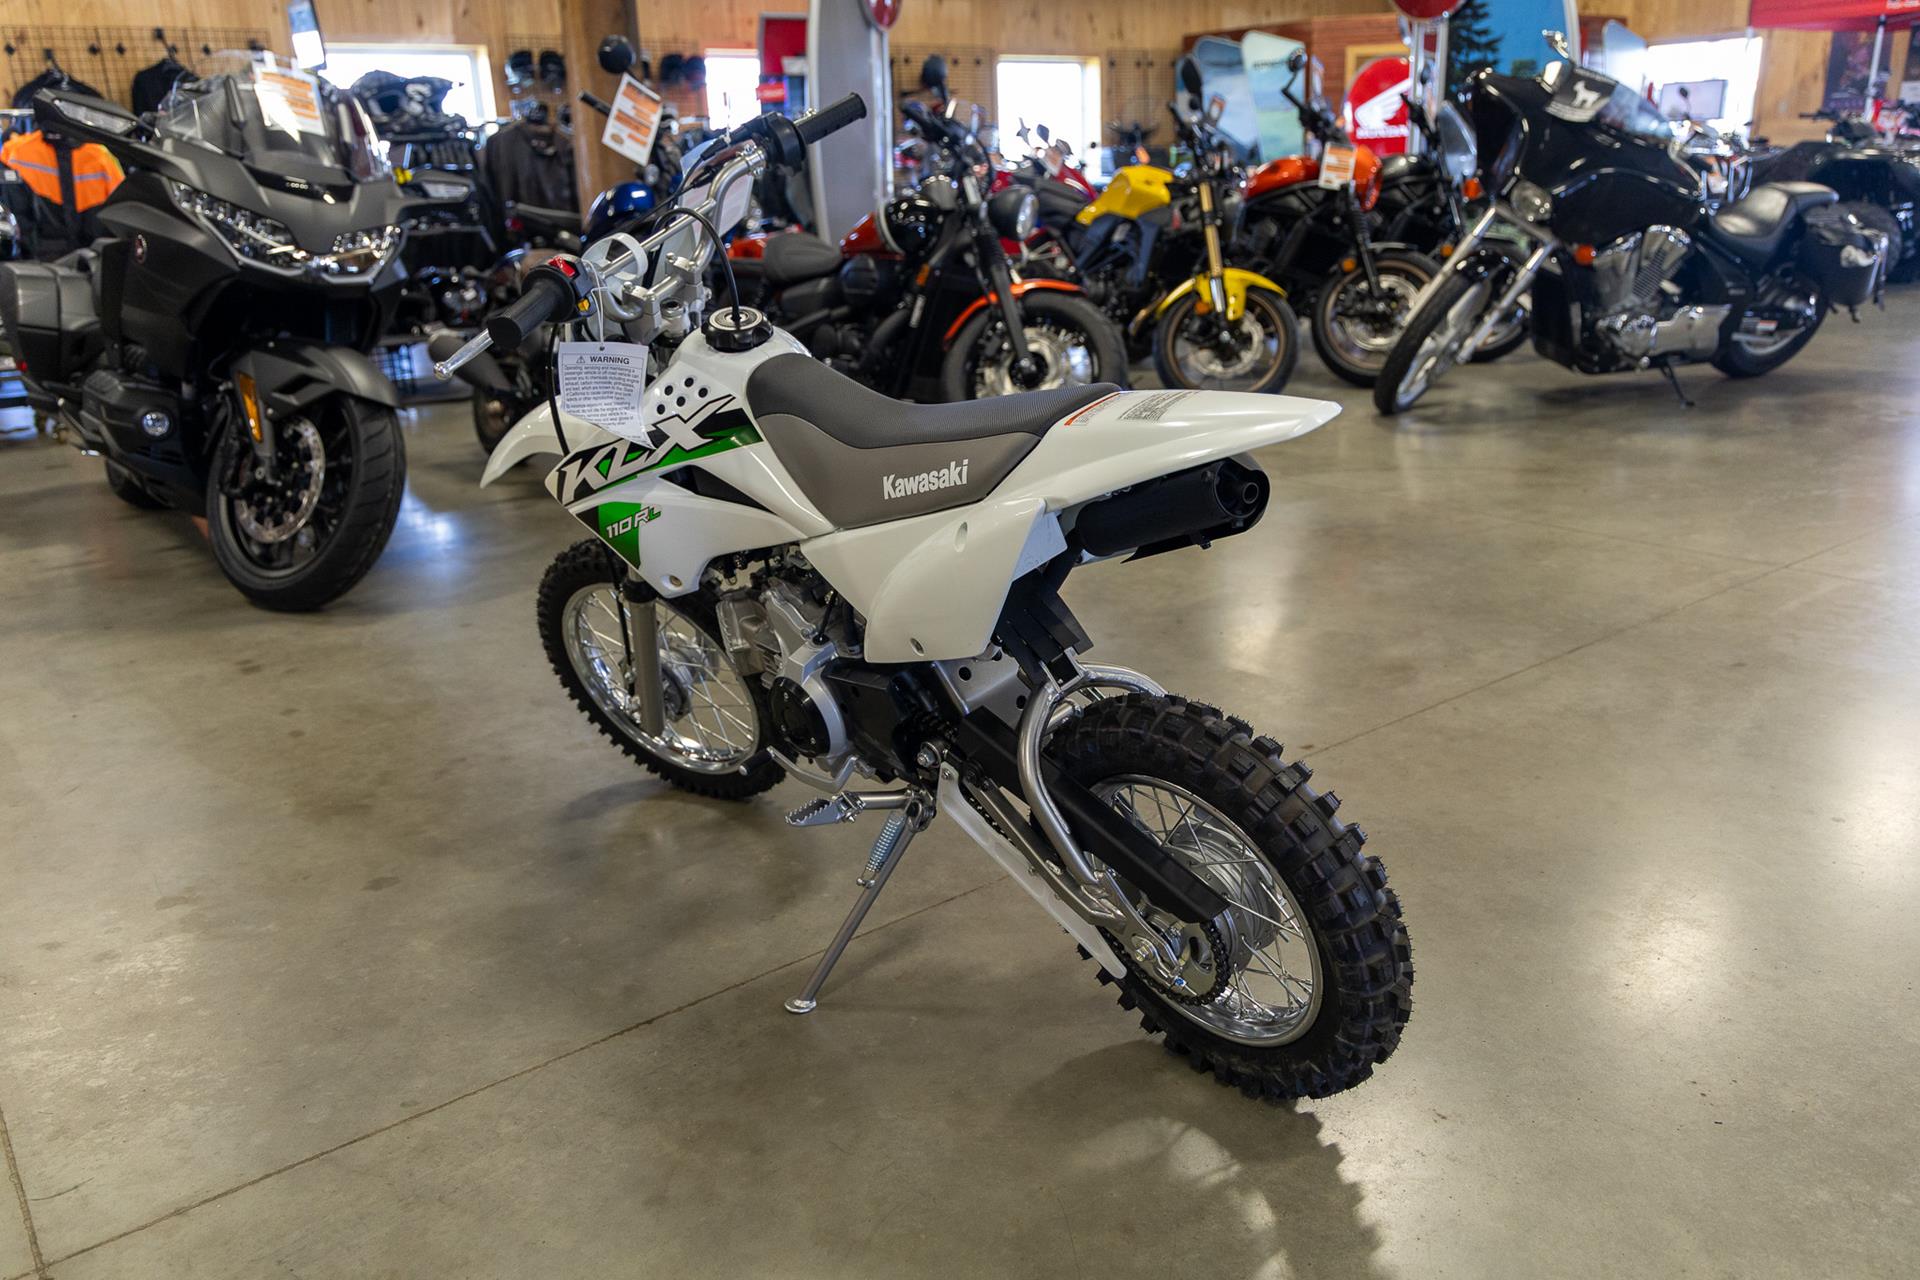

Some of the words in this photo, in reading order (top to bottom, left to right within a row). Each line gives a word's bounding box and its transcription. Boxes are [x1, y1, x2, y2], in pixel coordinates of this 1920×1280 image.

[590, 356, 630, 364] WARNING
[556, 394, 736, 505] KLX
[883, 458, 969, 500] Kawasaki
